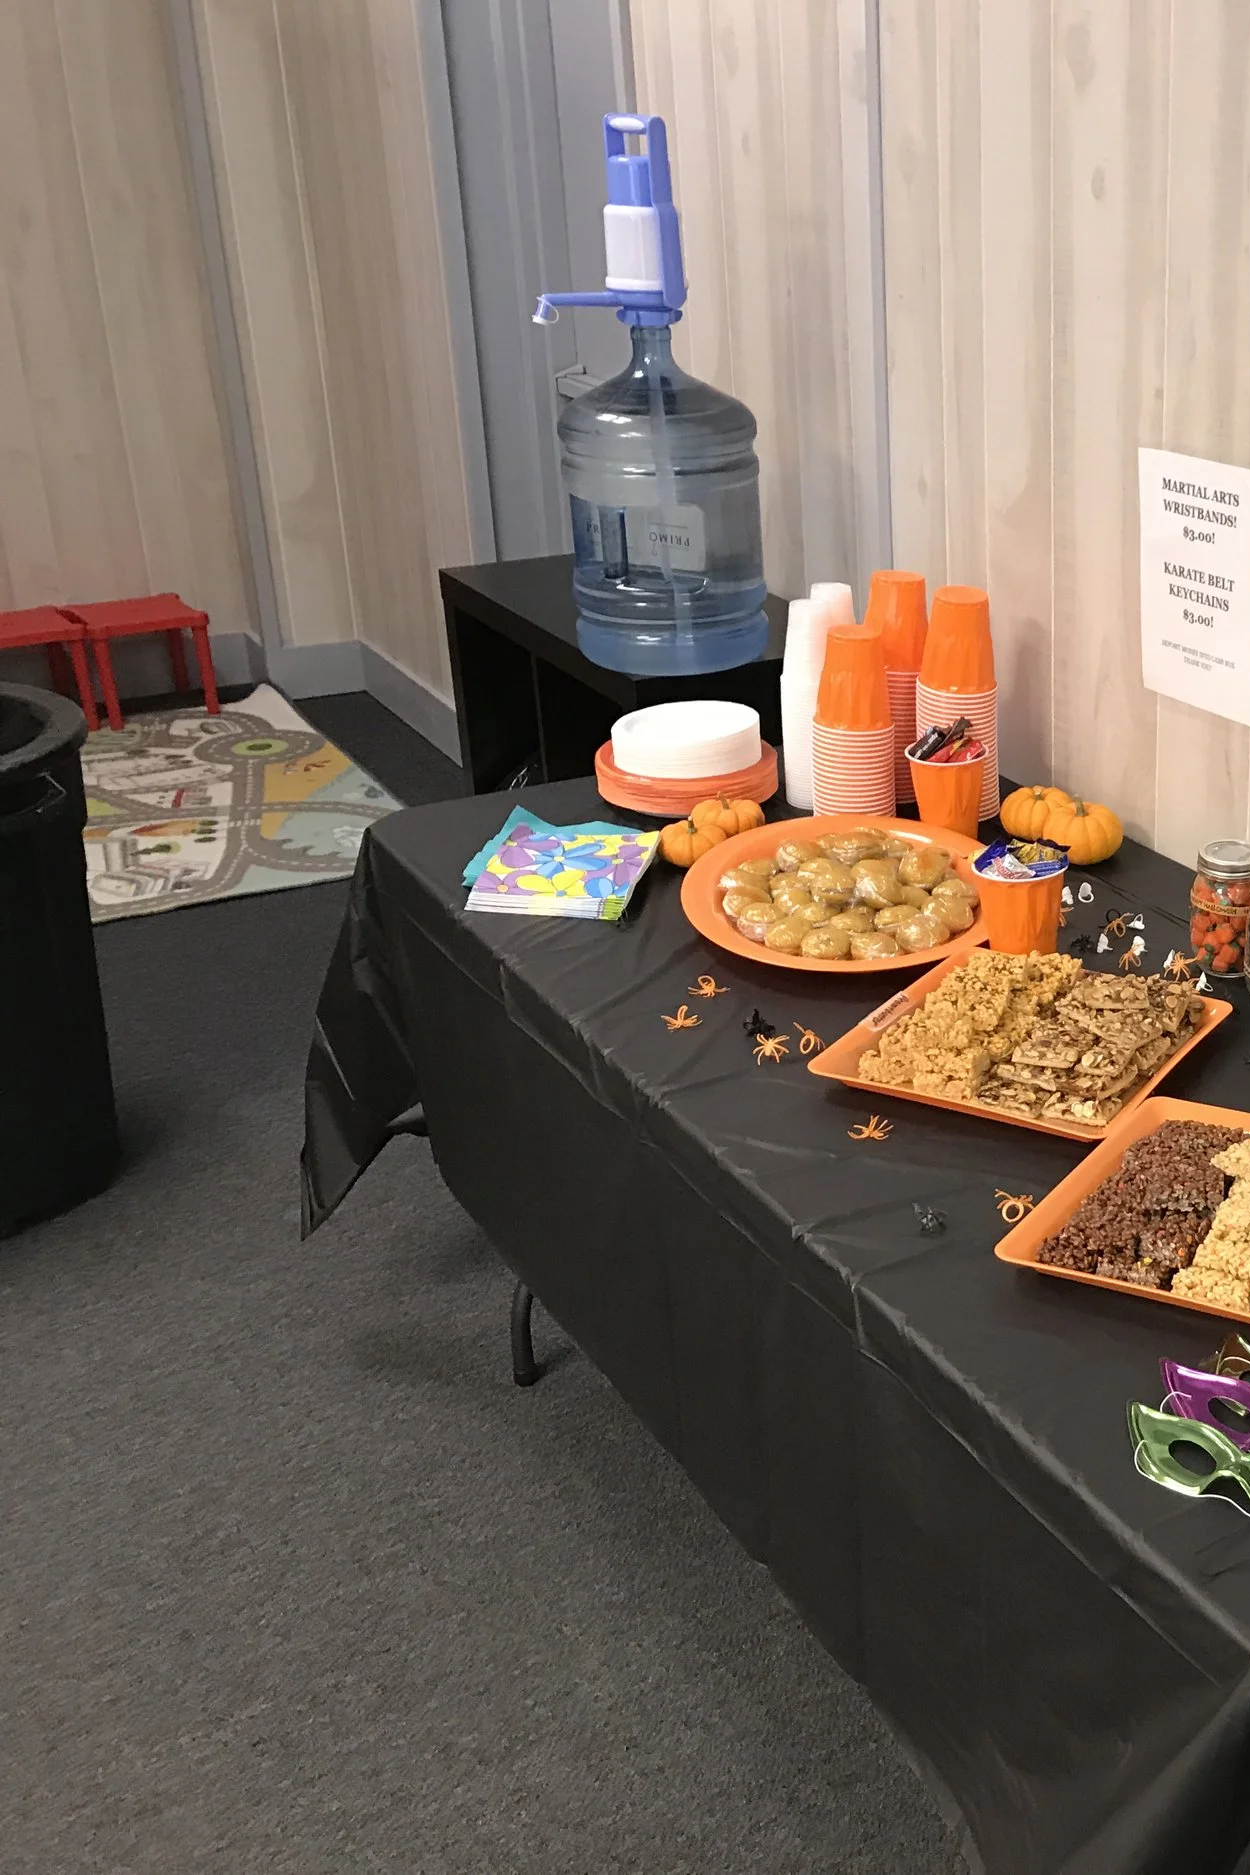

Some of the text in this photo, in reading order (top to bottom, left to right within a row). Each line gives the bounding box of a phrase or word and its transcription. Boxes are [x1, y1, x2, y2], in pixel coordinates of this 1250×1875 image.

[1162, 477, 1240, 507] MARTIAL ARTS
[1163, 499, 1237, 528] WRISTBANDS!
[649, 531, 690, 547] PRIMO
[1183, 526, 1215, 544] $3.00!
[1164, 561, 1235, 592] KARATE BELT
[1168, 583, 1230, 612] KEYCHAINS
[1183, 608, 1214, 628] $3.00!
